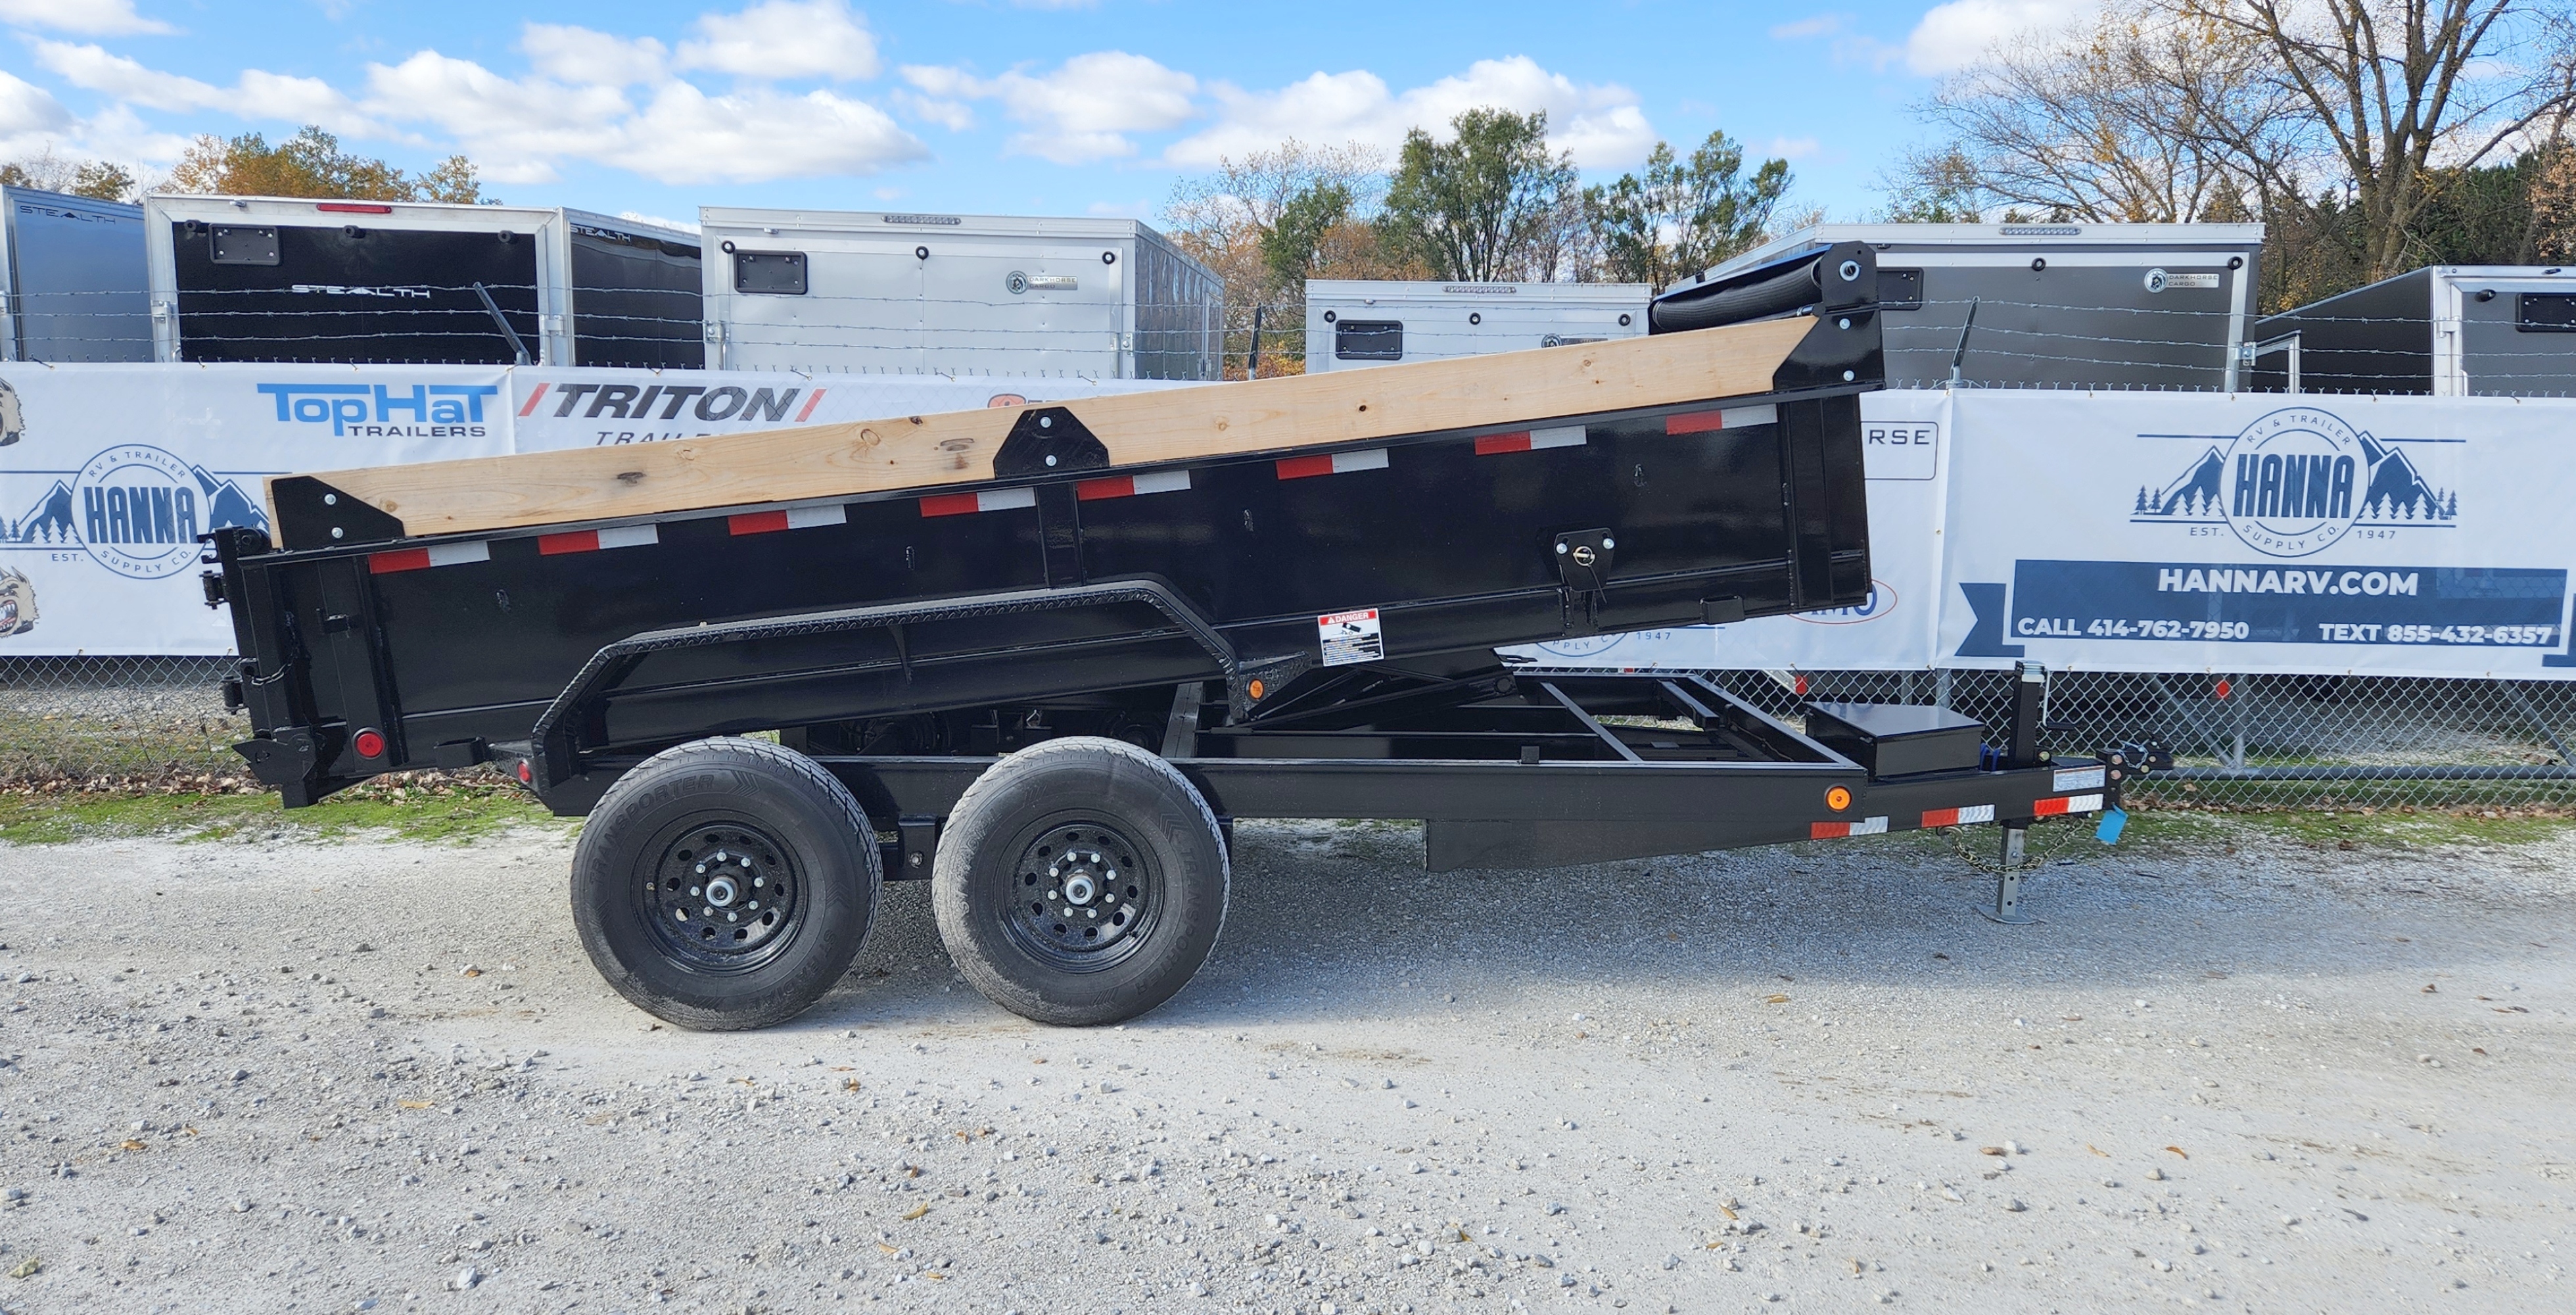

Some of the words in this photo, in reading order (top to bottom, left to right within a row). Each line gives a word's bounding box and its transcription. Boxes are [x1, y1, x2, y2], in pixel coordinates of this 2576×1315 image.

[20, 205, 116, 224] STEALTH
[570, 224, 631, 242] STEALTH
[292, 285, 430, 299] STEALTH
[553, 383, 801, 422] TRITON
[348, 425, 486, 437] TRAILERS
[2247, 427, 2263, 443] RV
[2290, 415, 2351, 445] TRAILER
[89, 463, 103, 477] RV
[125, 451, 185, 478] TRAILER
[2233, 454, 2354, 518] HANNA
[83, 487, 198, 544] HANNA
[2190, 527, 2224, 537] EST.
[2243, 525, 2305, 550] SUPPLY
[2318, 527, 2339, 542] CO.
[2357, 531, 2396, 539] 1947
[52, 553, 83, 562] EST.
[101, 550, 162, 573] SUPPLY
[172, 551, 191, 565] CO.
[2157, 568, 2419, 596] HANNARV.COM
[1335, 612, 1369, 622] DANGER
[2018, 617, 2082, 636] CALL
[2087, 618, 2249, 640] 414-762-7950
[1553, 639, 1589, 650] PPLY
[2318, 623, 2382, 642] TEXT
[2387, 625, 2552, 644] 855-432-6357
[590, 774, 714, 886] TRANSPORTER
[1136, 847, 1204, 995] TRANSPORTER
